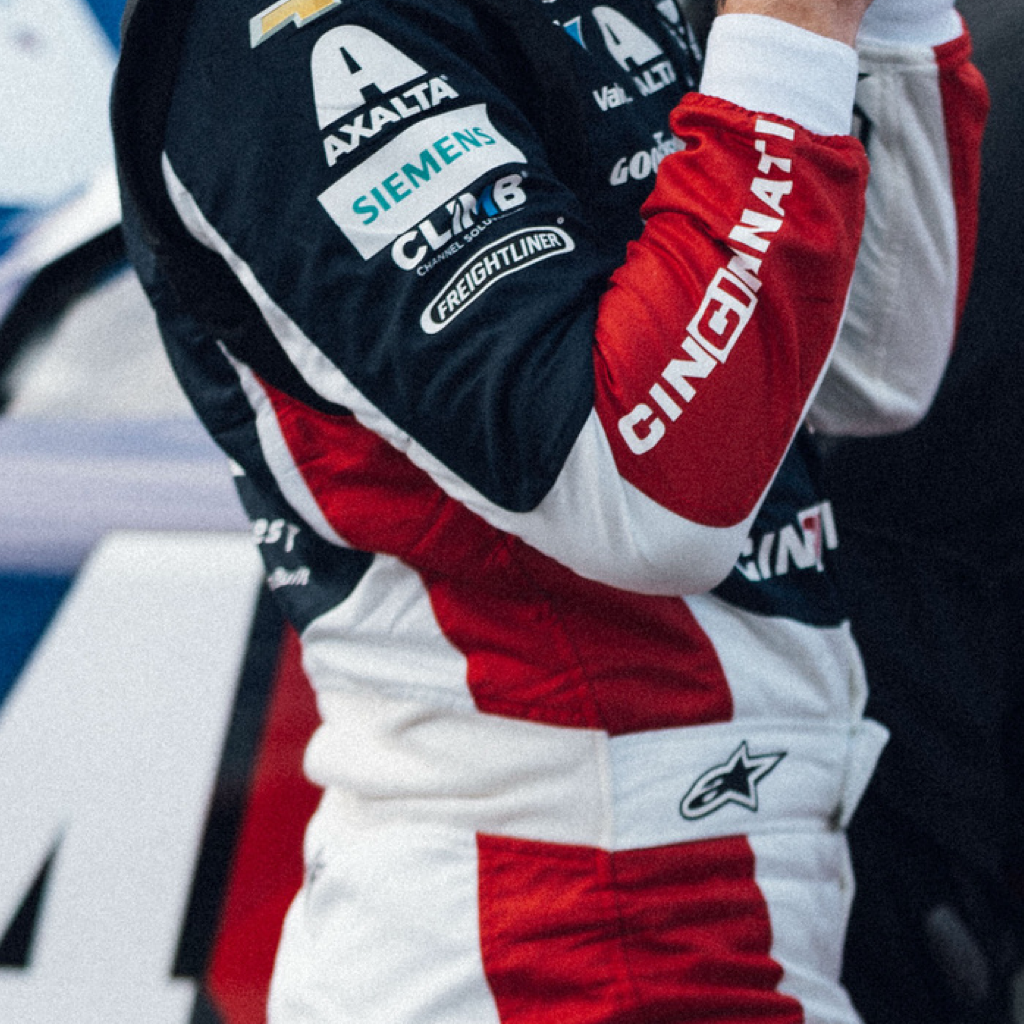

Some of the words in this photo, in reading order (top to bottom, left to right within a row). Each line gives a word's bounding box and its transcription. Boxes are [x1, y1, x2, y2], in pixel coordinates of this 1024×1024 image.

[322, 78, 459, 168] AXALTA
[351, 126, 497, 225] SIEMENS
[436, 232, 562, 321] FREIGHTLINER
[617, 118, 796, 456] CINCINNATI
